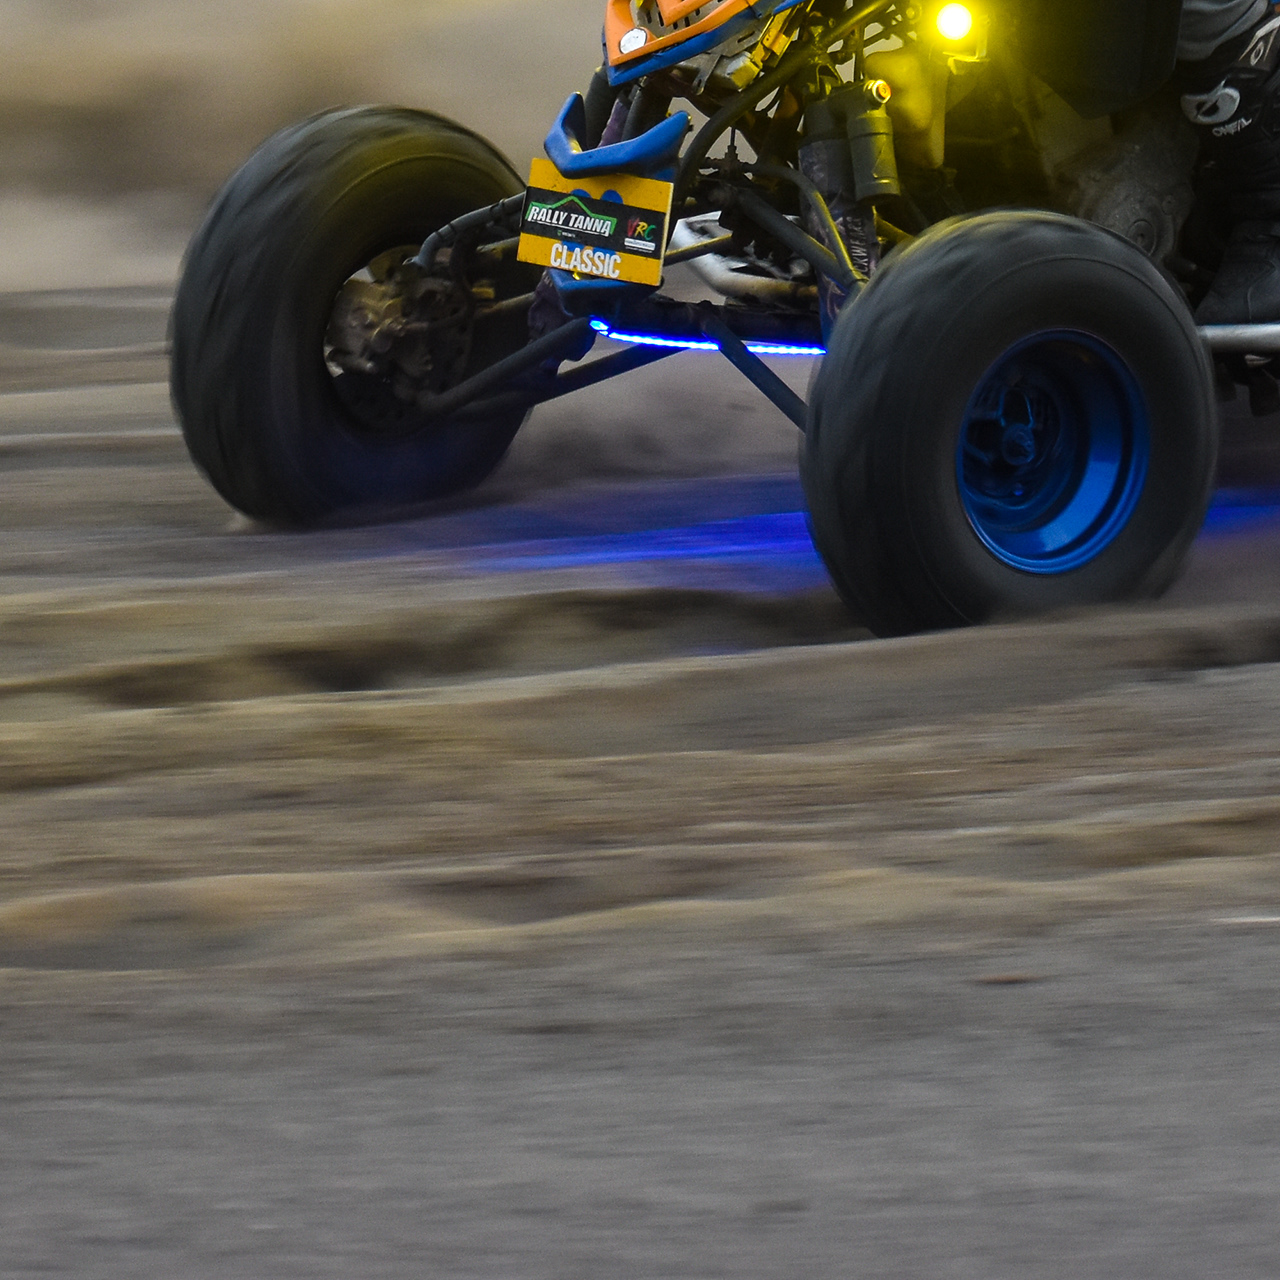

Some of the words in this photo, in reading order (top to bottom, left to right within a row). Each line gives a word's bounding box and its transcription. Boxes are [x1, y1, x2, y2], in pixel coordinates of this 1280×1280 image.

[527, 206, 569, 226] RALLY
[570, 213, 612, 237] TANNA
[627, 217, 657, 241] VRC
[550, 243, 621, 278] CLASSIC
